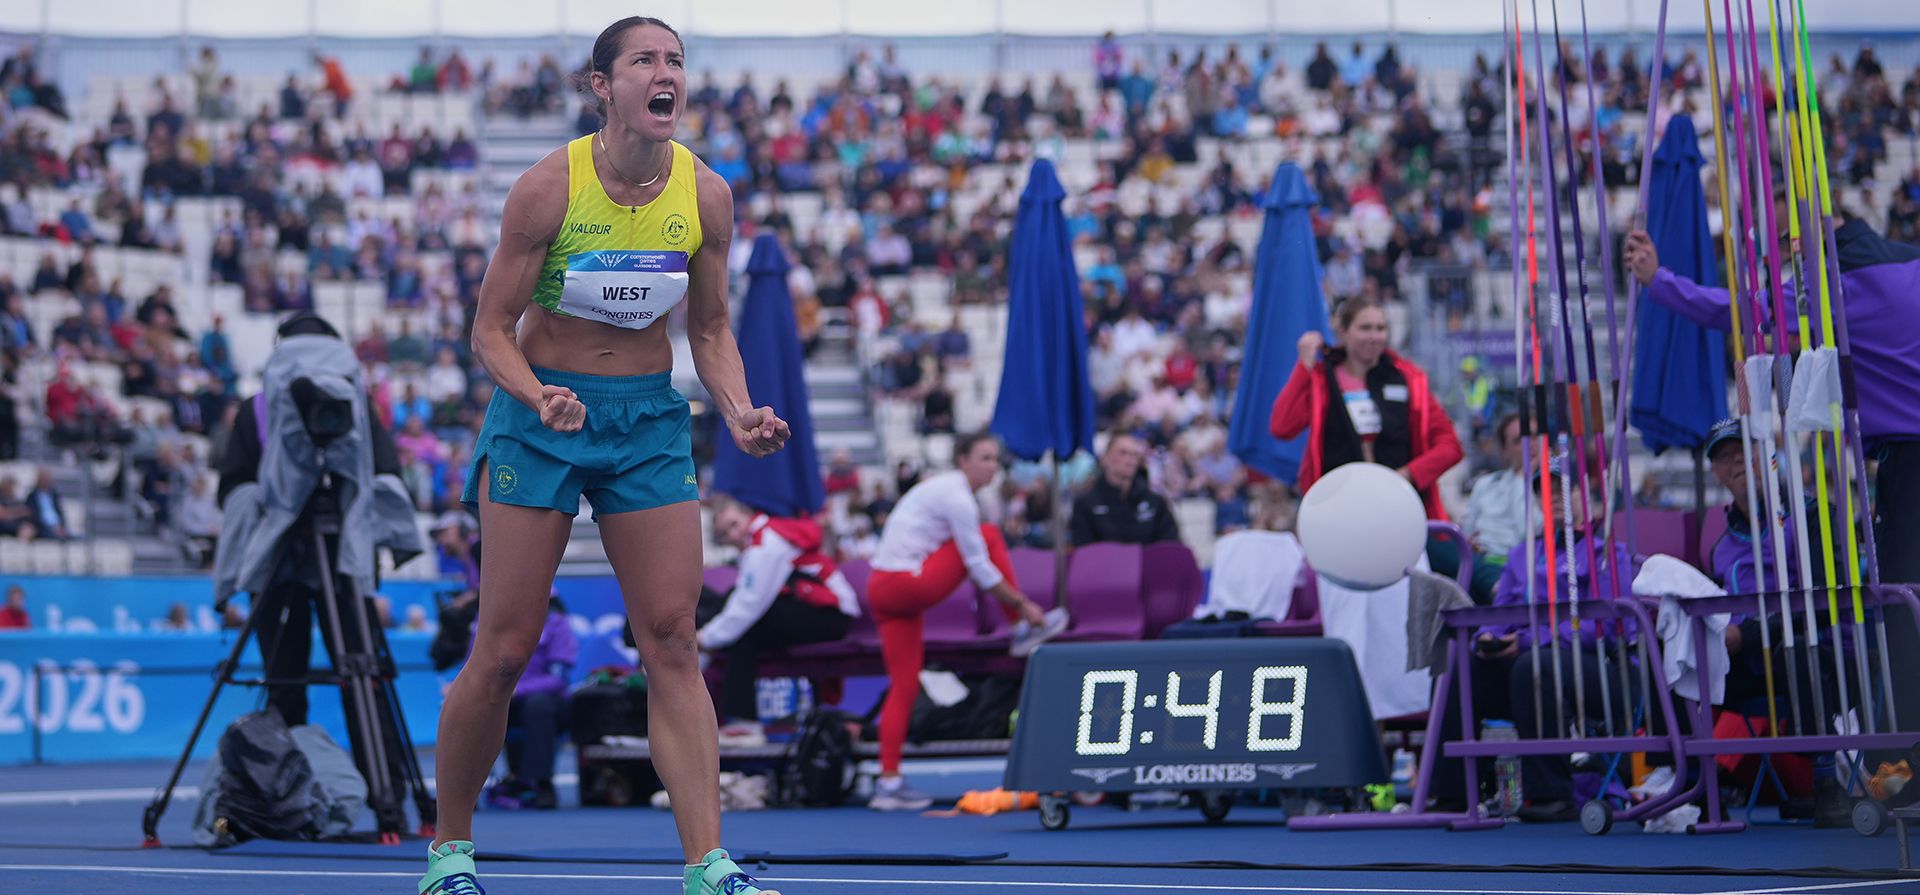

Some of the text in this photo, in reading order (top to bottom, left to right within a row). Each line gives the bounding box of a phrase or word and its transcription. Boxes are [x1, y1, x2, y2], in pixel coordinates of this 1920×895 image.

[570, 223, 611, 234] VALOUR
[602, 286, 651, 301] WEST
[592, 307, 653, 319] LONGINES
[0, 658, 145, 734] 2026
[1134, 763, 1257, 784] LONGINES
